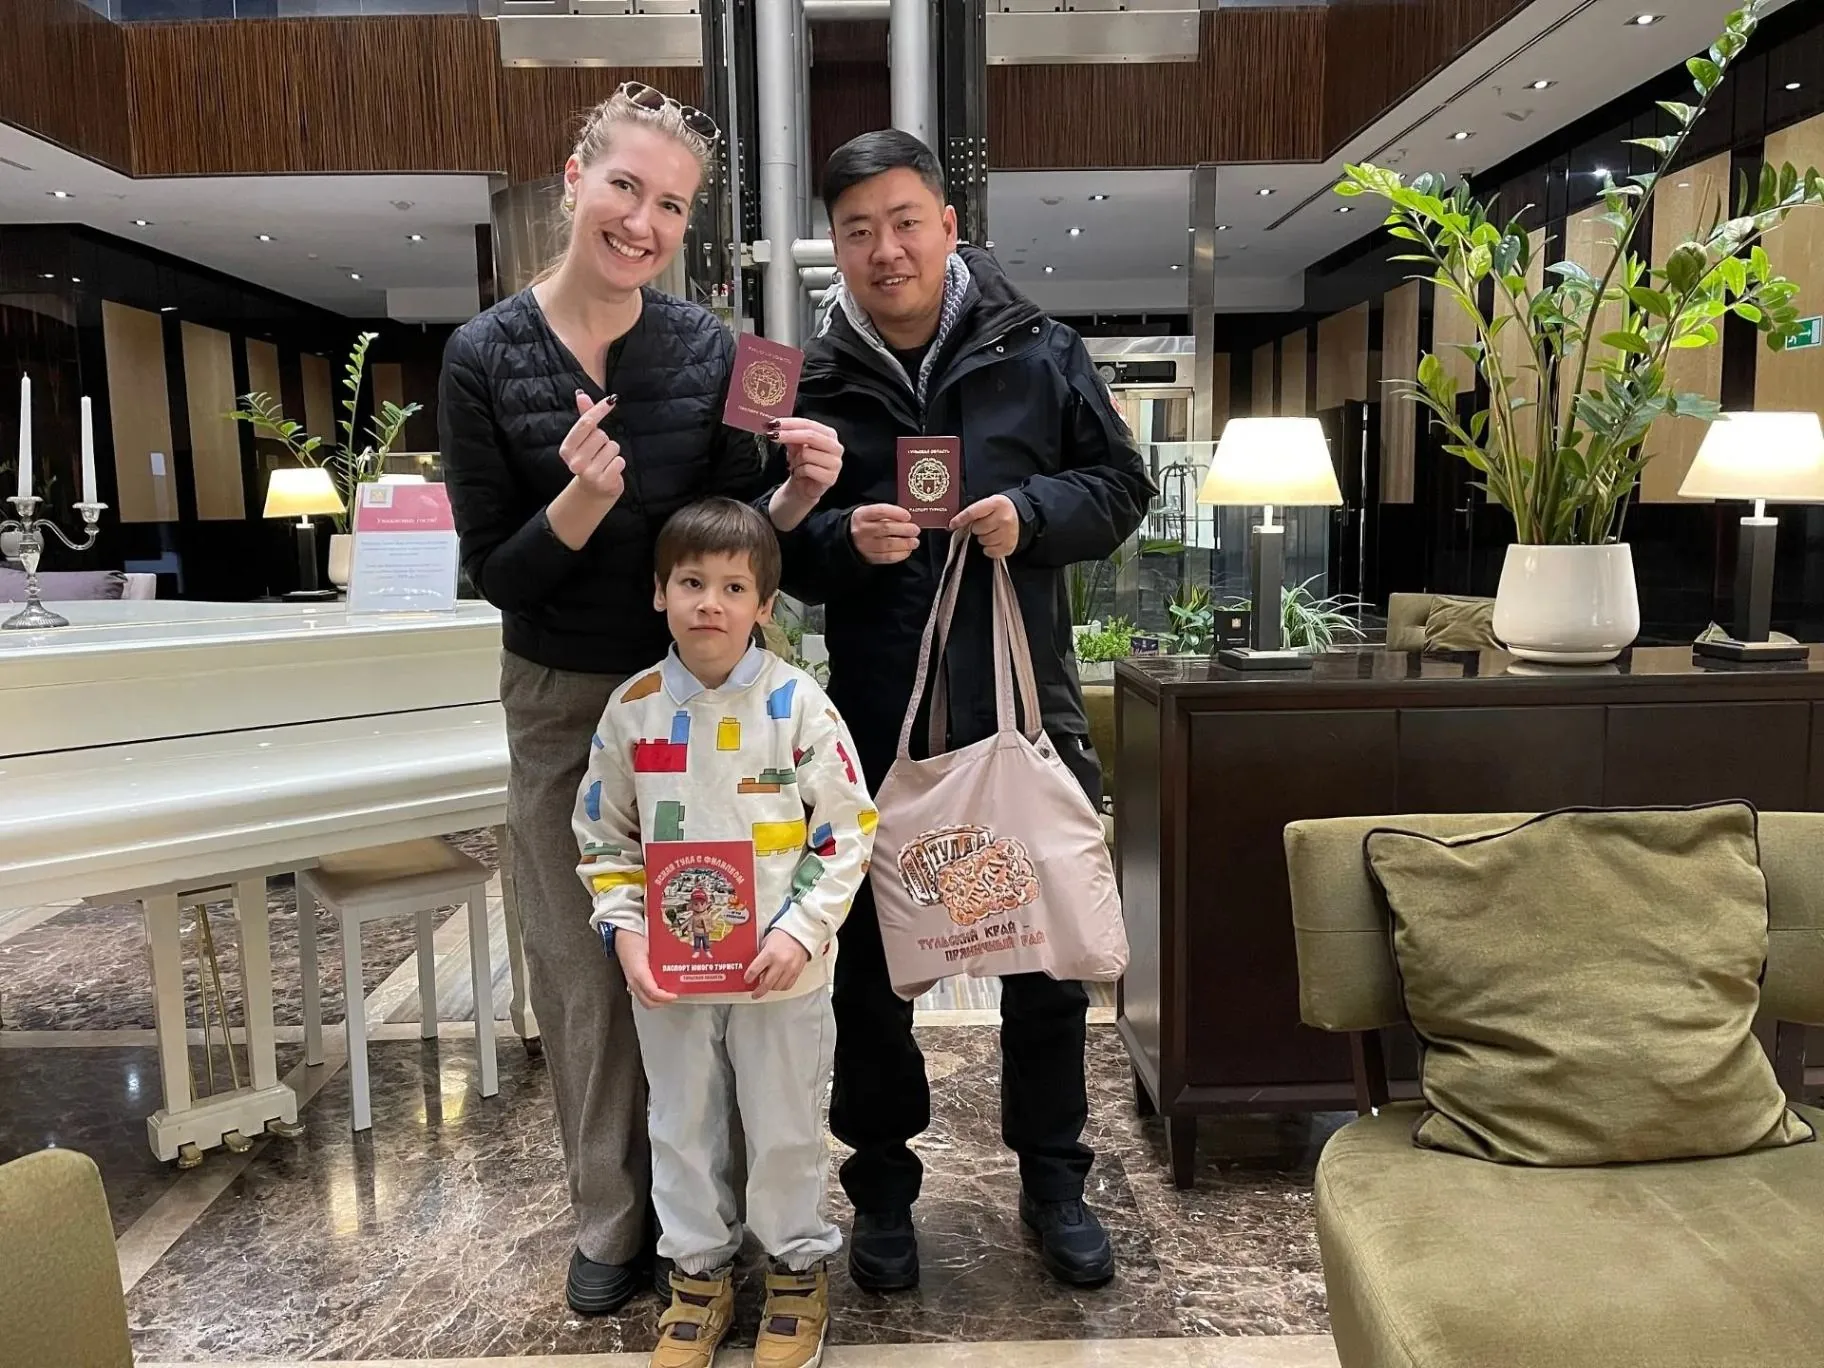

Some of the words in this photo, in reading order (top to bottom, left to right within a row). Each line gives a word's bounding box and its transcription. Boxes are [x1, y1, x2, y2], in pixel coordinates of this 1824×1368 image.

[674, 855, 696, 868] ТУЛА
[696, 855, 702, 863] С
[703, 856, 745, 885] ФИЛИПКОМ
[917, 928, 979, 951] ТУЛЬСКИЙ
[983, 920, 1017, 938] КРАЙ
[944, 935, 1015, 962] ПРЯНИЧНЫЙ
[1020, 930, 1046, 947] РАЙ
[662, 964, 690, 972] ПАСПОРТ
[691, 963, 714, 971] ЮНОГО
